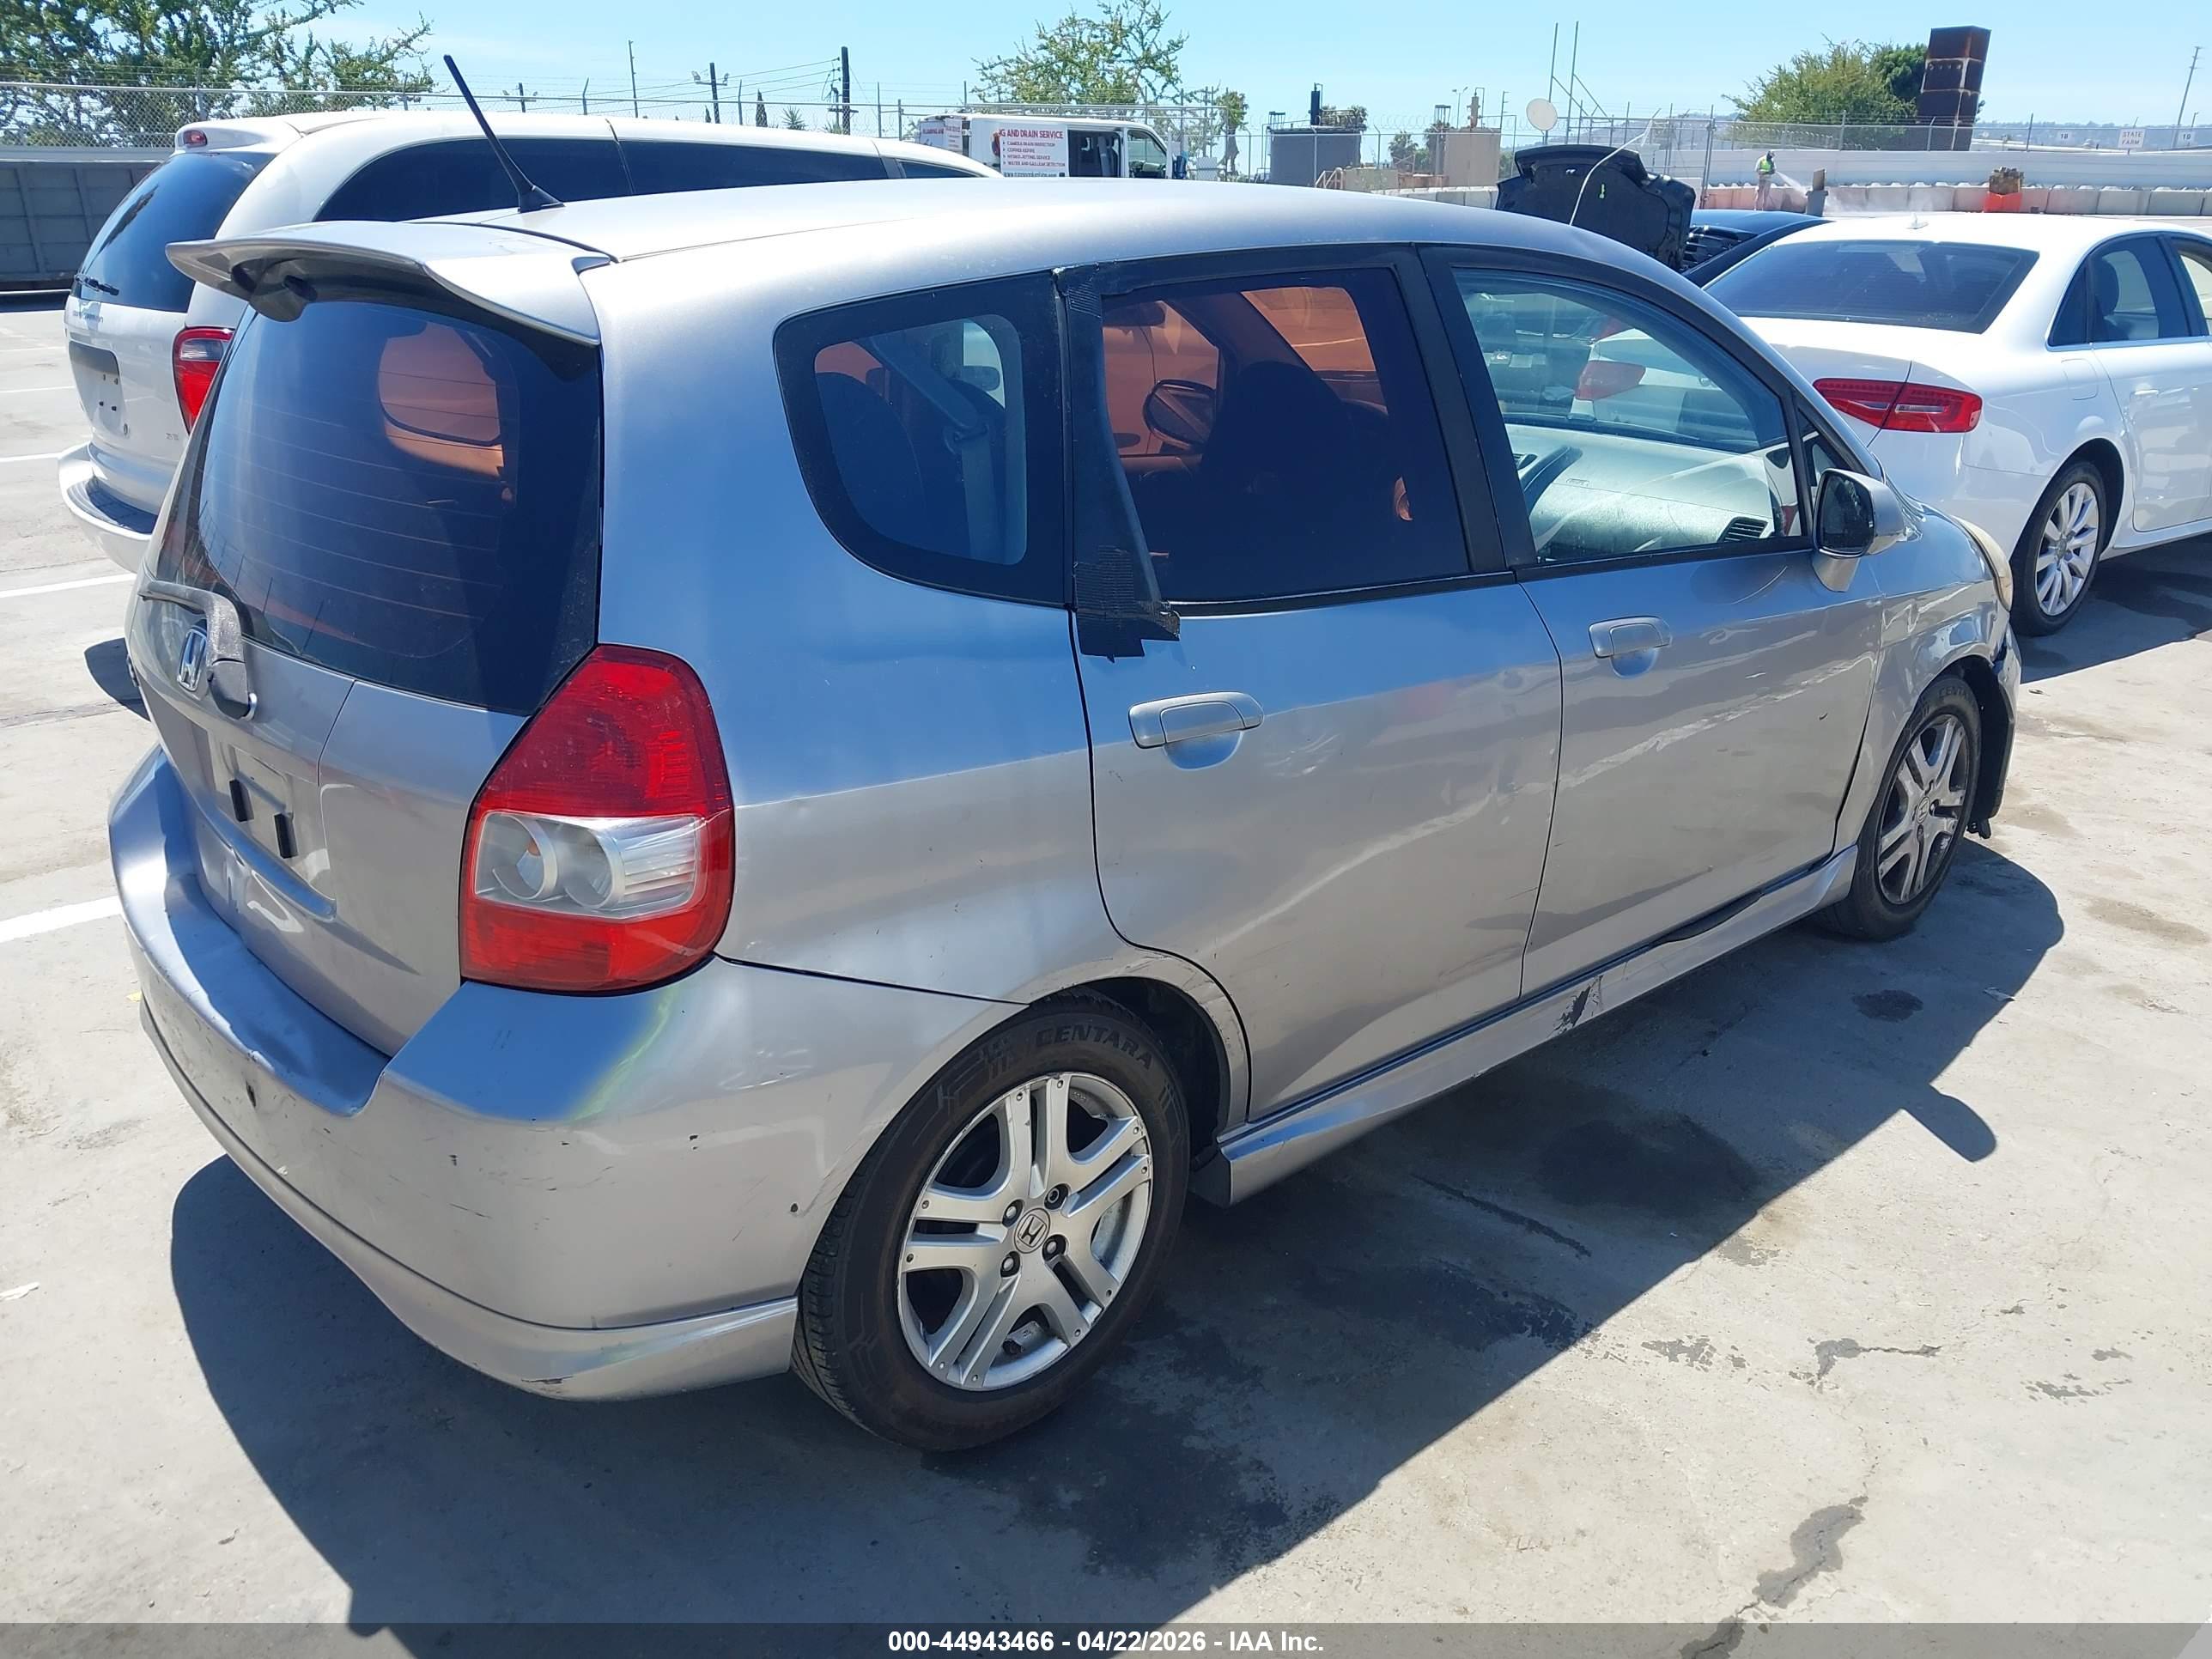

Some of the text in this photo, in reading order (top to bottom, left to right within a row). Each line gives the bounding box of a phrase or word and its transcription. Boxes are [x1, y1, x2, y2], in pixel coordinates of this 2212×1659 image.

[1007, 129, 1020, 137] AND
[1020, 130, 1038, 138] DRAIN
[1039, 131, 1064, 139] SERVICE
[1036, 1024, 1154, 1070] CENTARA
